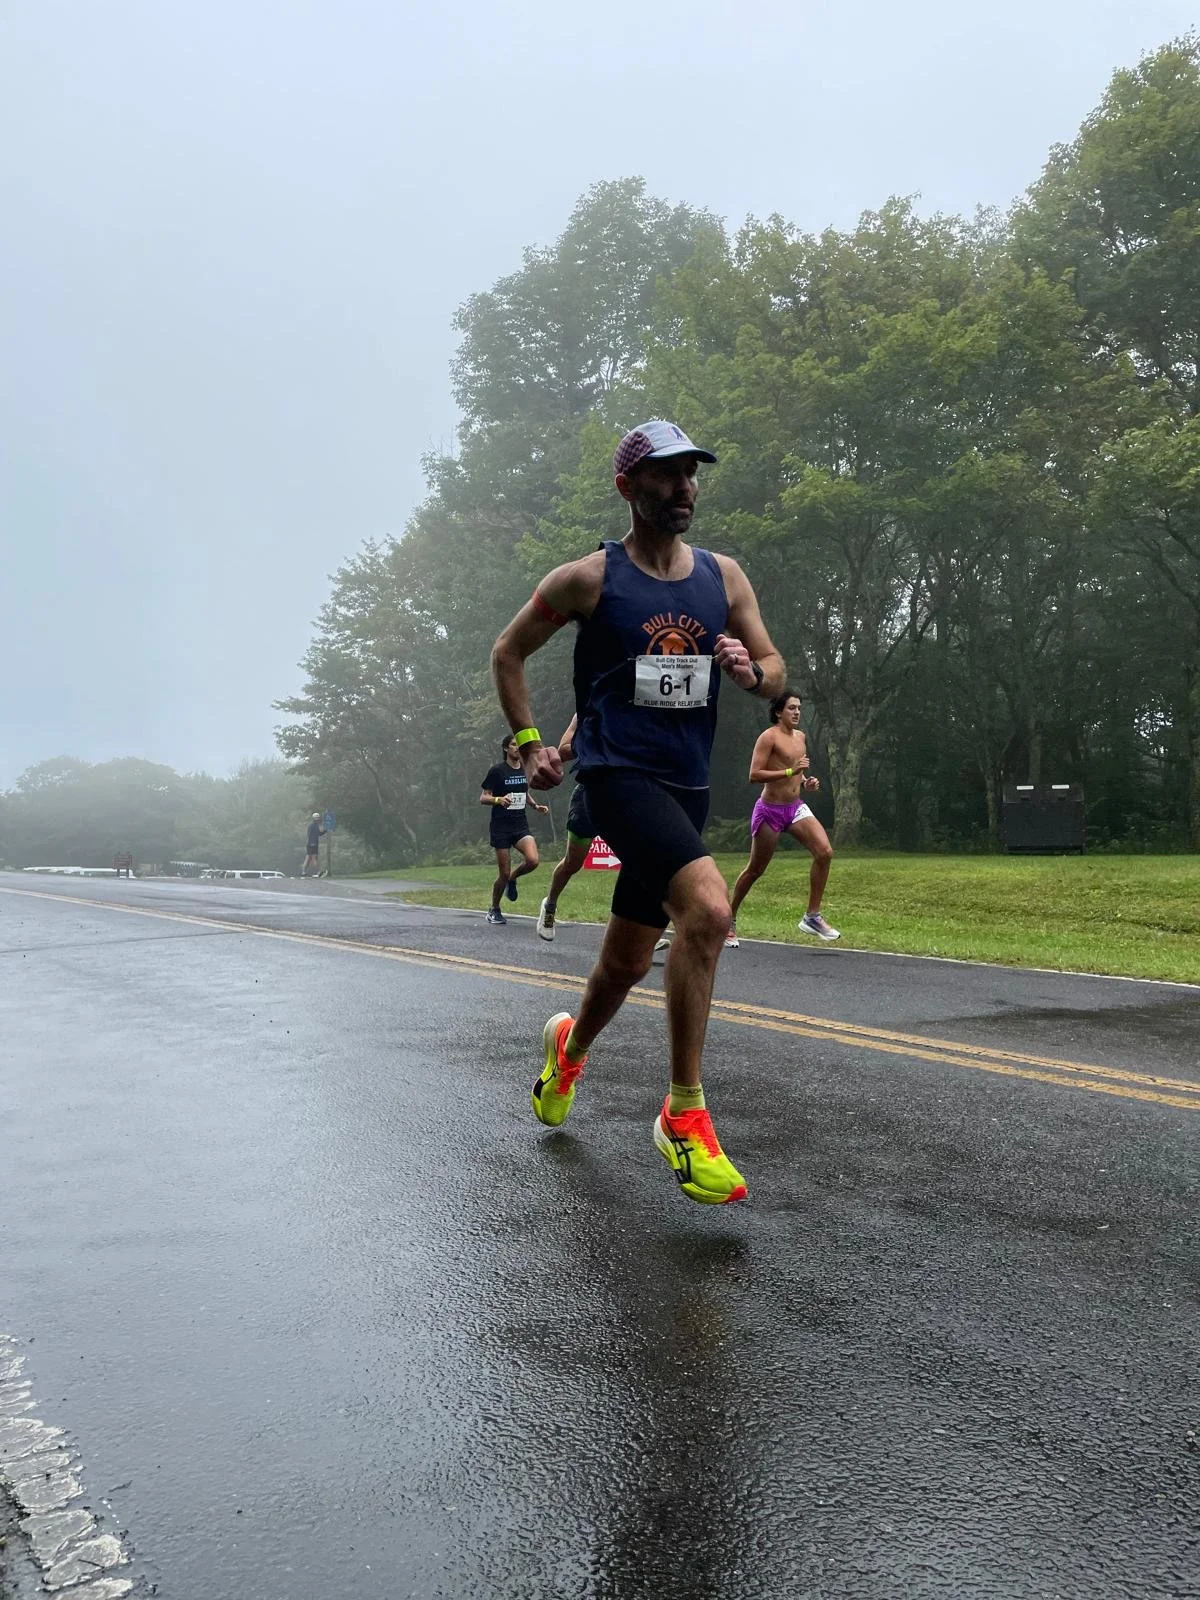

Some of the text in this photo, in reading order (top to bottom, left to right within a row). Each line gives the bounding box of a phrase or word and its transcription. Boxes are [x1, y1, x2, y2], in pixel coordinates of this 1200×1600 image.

[642, 612, 707, 638] BULL CITY
[660, 674, 691, 696] 6-1
